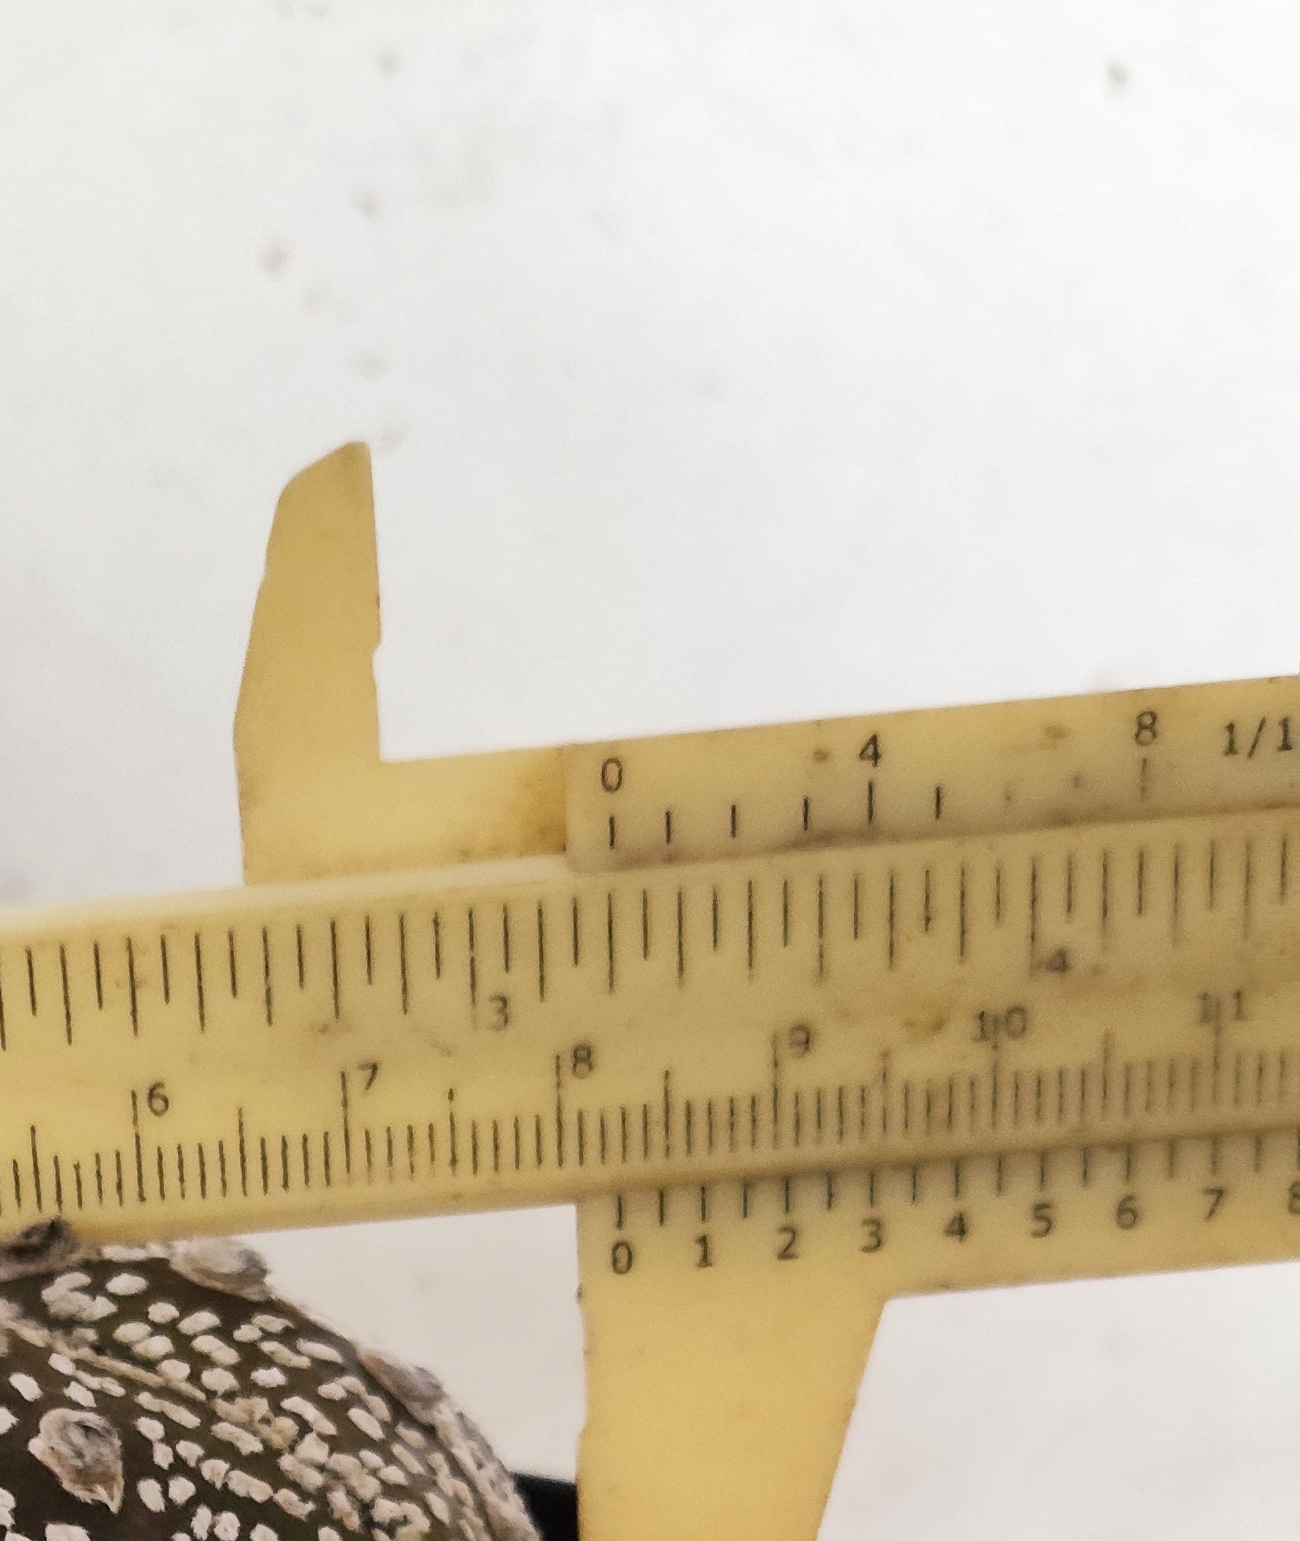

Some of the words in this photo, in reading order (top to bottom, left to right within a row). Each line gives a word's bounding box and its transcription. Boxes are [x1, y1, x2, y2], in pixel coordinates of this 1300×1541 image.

[601, 758, 624, 793] 0
[858, 733, 882, 768] 4
[1134, 710, 1159, 746] 8
[489, 994, 511, 1032] 3
[146, 1081, 171, 1116] 6
[356, 1061, 380, 1093] 7
[571, 1042, 596, 1080] 8
[972, 1004, 1029, 1044] 10
[610, 1240, 635, 1276] 0
[694, 1235, 714, 1269] 1
[775, 1227, 801, 1261] 2
[860, 1219, 884, 1253] 3
[942, 1209, 969, 1243] 4
[1030, 1203, 1056, 1239] 5
[1115, 1195, 1139, 1231] 6
[1201, 1186, 1227, 1222] 7
